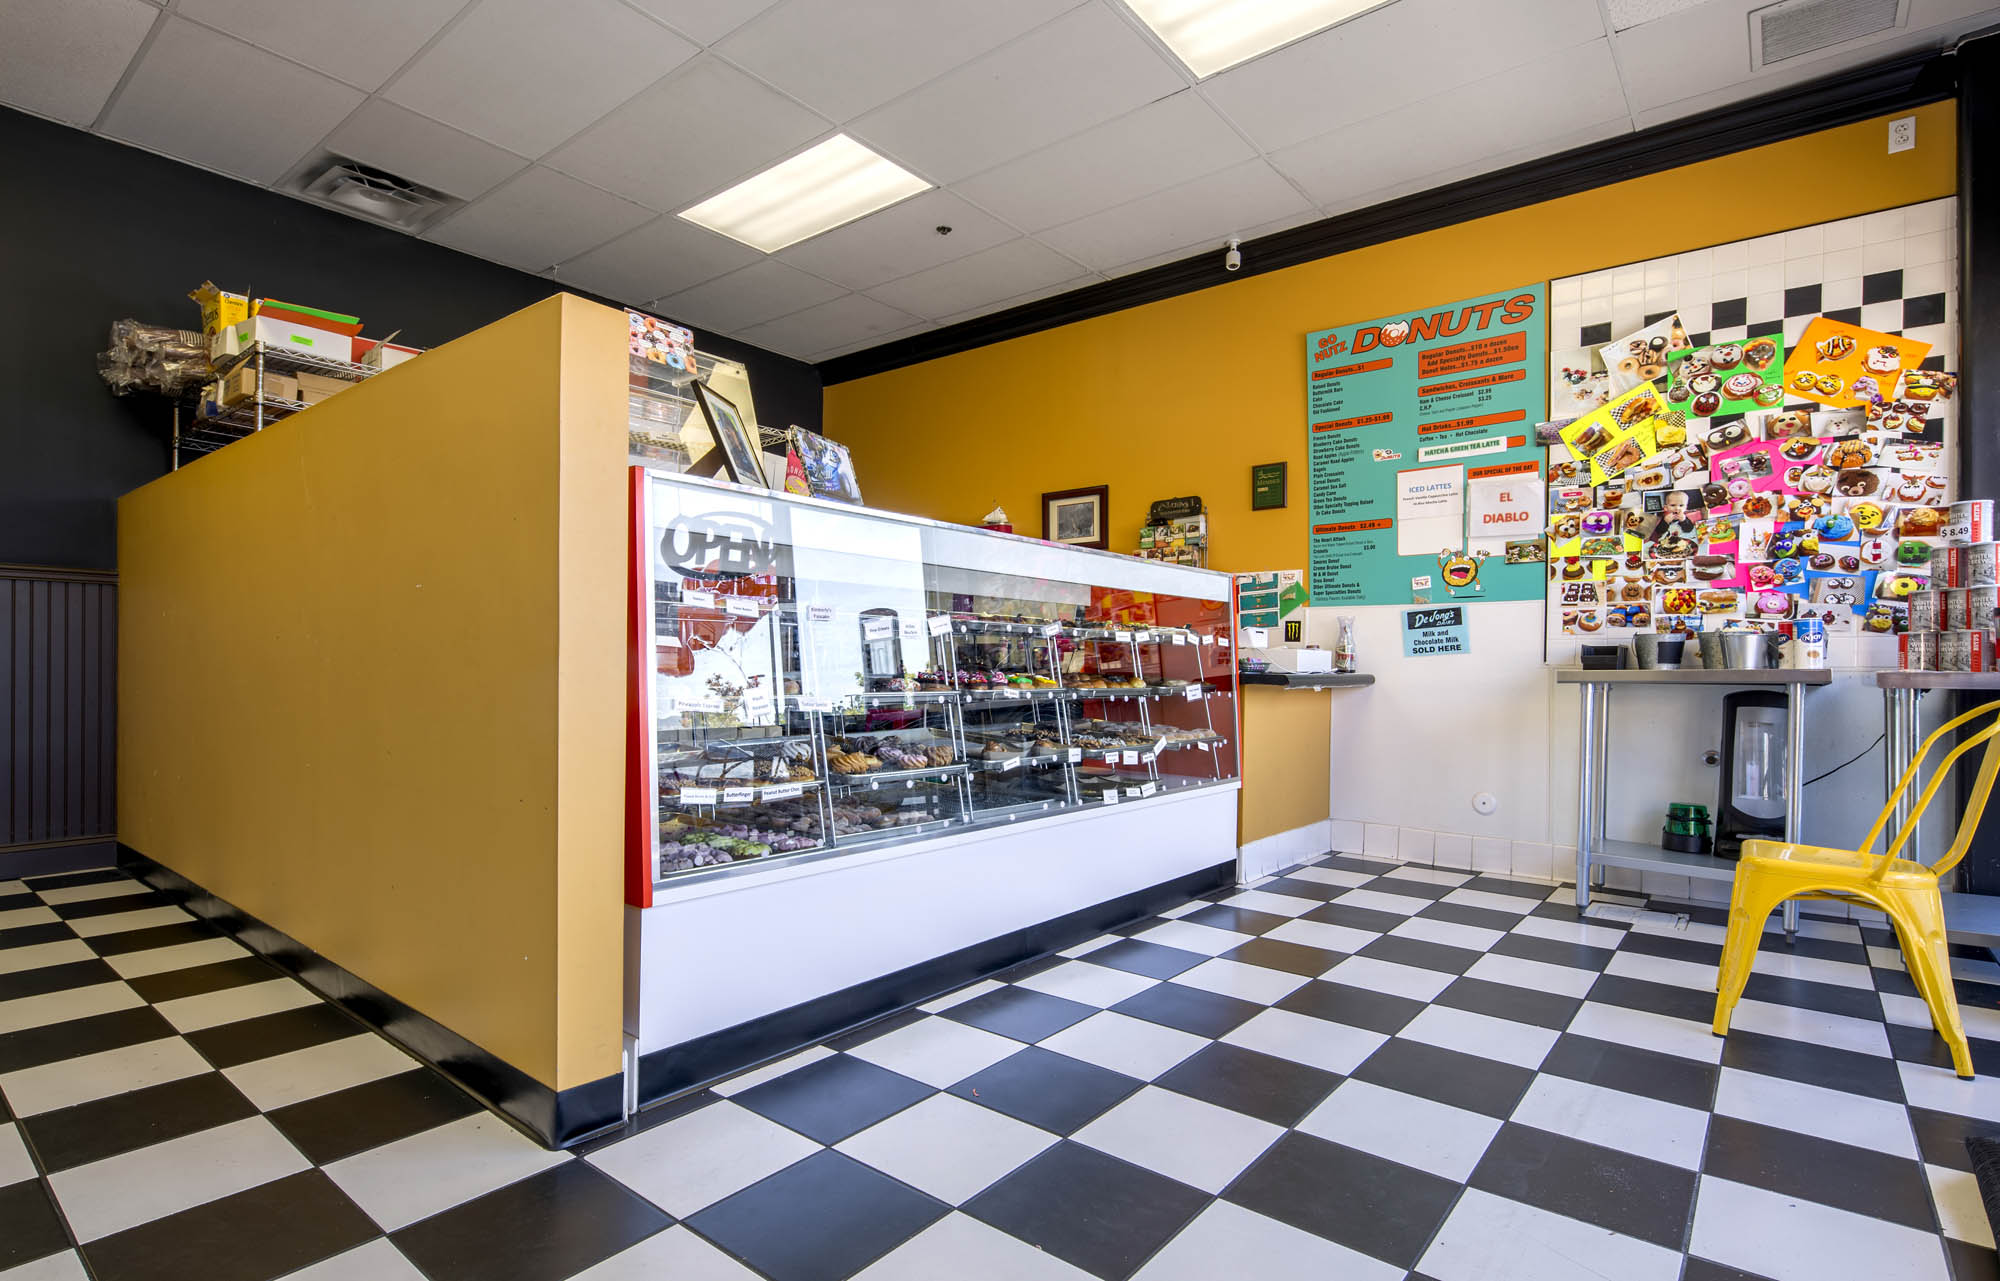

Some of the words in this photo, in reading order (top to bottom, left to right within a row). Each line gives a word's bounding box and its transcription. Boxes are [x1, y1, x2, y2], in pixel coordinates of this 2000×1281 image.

[1350, 293, 1535, 355] DONUTS
[1318, 334, 1337, 349] GO
[1314, 340, 1348, 363] NUTZ
[1465, 428, 1488, 436] Chocolate
[1482, 440, 1500, 449] LATTE
[1484, 467, 1504, 476] SPECIAL
[1426, 482, 1452, 492] LATTES
[1499, 492, 1513, 503] EL
[1483, 511, 1530, 524] DIABLO
[1942, 528, 1948, 538] $
[1950, 526, 1969, 536] 8.49
[1414, 638, 1444, 646] Chocolate
[1412, 646, 1436, 654] SOLD
[1438, 644, 1462, 652] HERE
